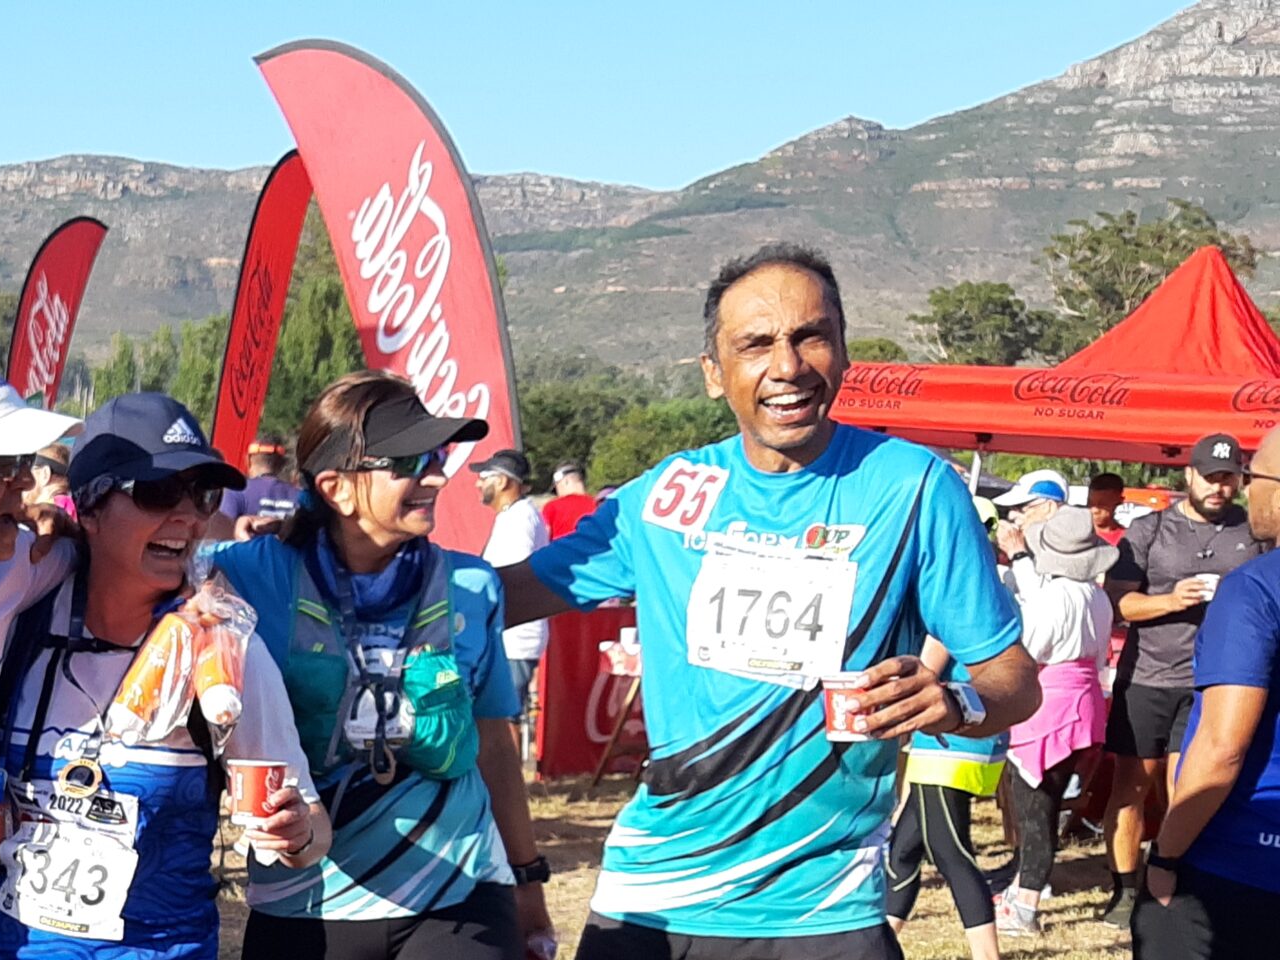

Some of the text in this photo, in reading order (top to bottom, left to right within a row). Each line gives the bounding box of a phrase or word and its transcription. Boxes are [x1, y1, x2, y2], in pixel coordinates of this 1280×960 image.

[843, 365, 929, 396] ca-Cola
[1014, 369, 1139, 406] Coca-Cola
[838, 397, 902, 410] NO SUGAR
[1033, 406, 1106, 421] NO SUGAR
[1253, 419, 1276, 429] NO
[652, 468, 719, 526] 55
[709, 587, 824, 642] 1764
[48, 792, 84, 815] 2022
[91, 798, 124, 816] ASA
[29, 849, 109, 906] 343
